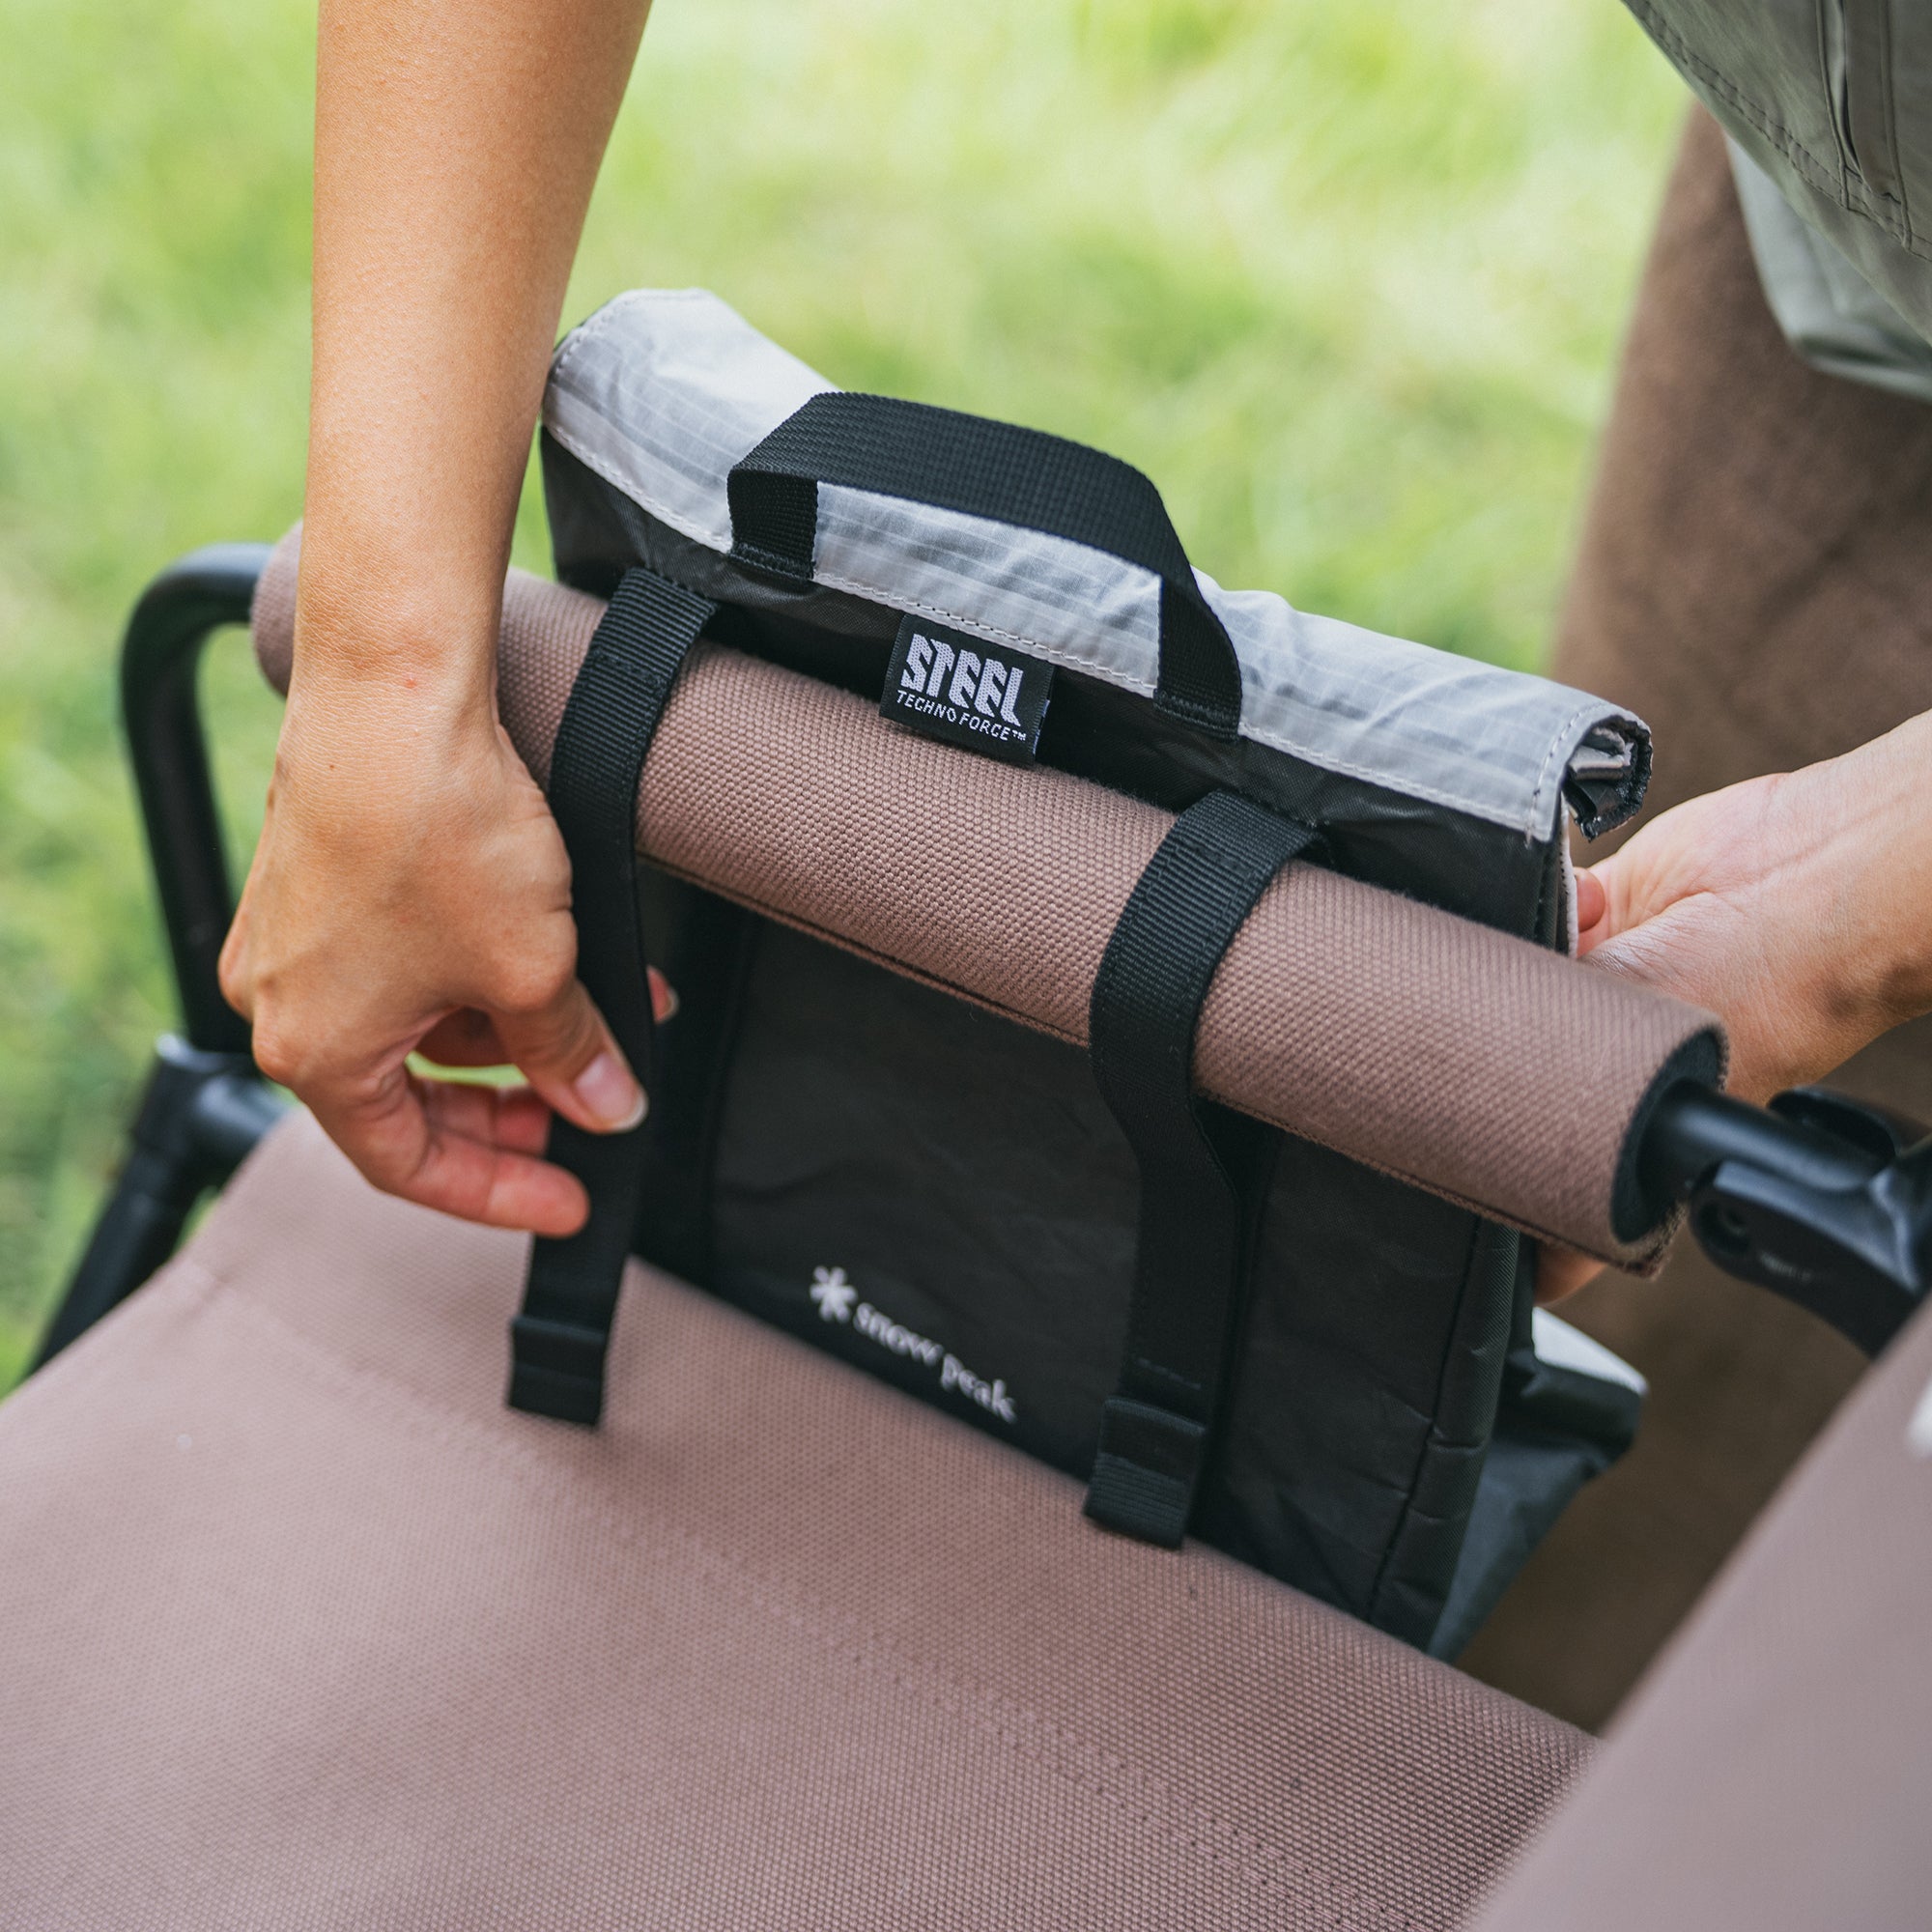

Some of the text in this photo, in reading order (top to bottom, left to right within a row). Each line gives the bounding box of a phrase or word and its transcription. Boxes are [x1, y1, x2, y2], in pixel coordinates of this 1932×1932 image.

[897, 691, 957, 723] TECHNO
[901, 634, 1023, 726] STEEL
[854, 1303, 1016, 1423] snow peak
